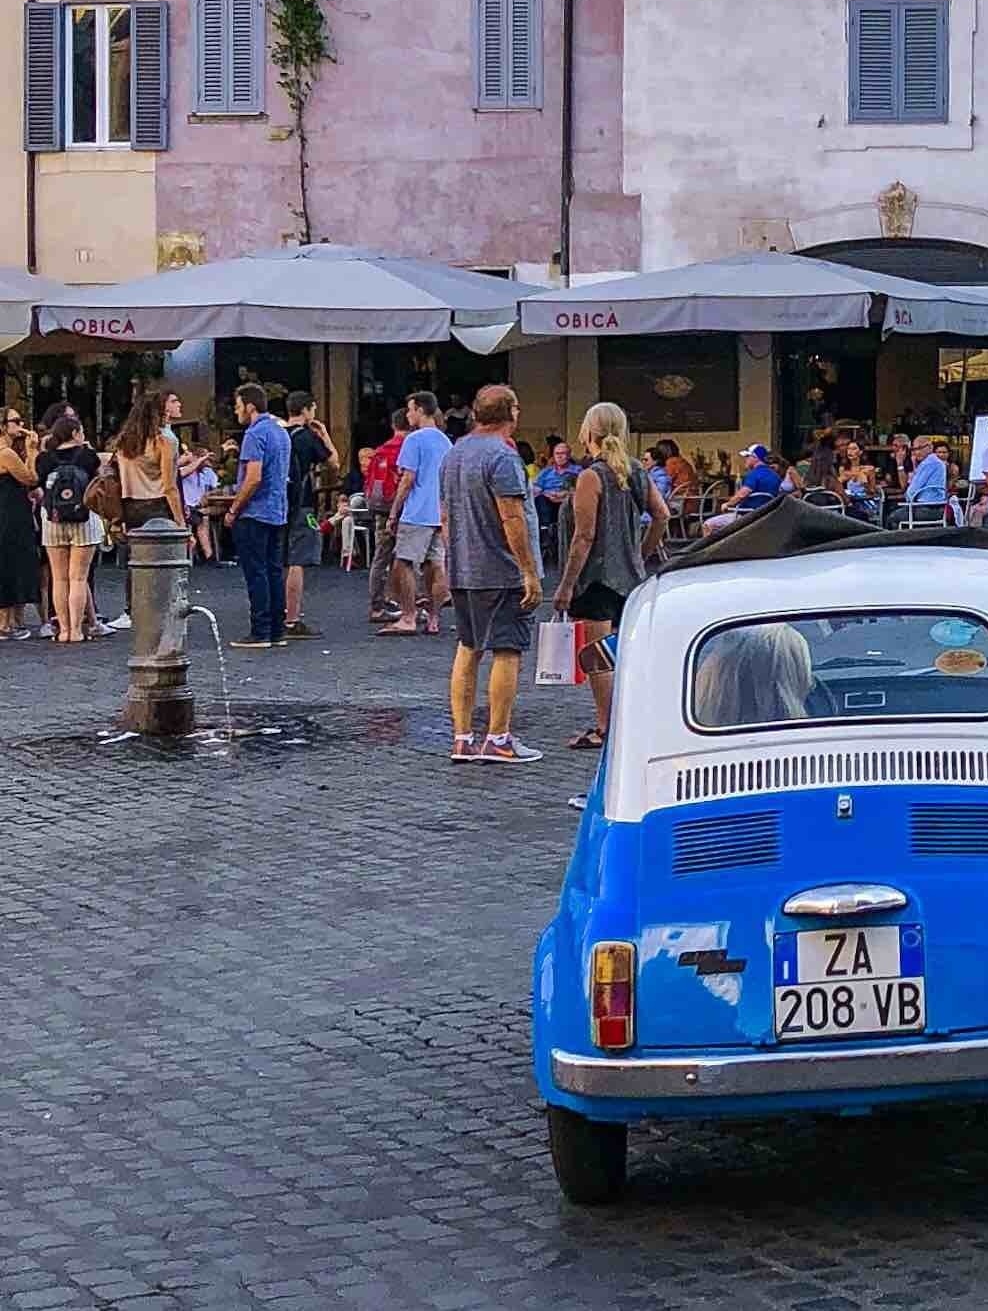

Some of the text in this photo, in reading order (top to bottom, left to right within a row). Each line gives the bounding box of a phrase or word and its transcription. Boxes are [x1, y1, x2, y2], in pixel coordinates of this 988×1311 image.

[825, 931, 873, 976] ZA
[780, 982, 921, 1033] 208 VB
